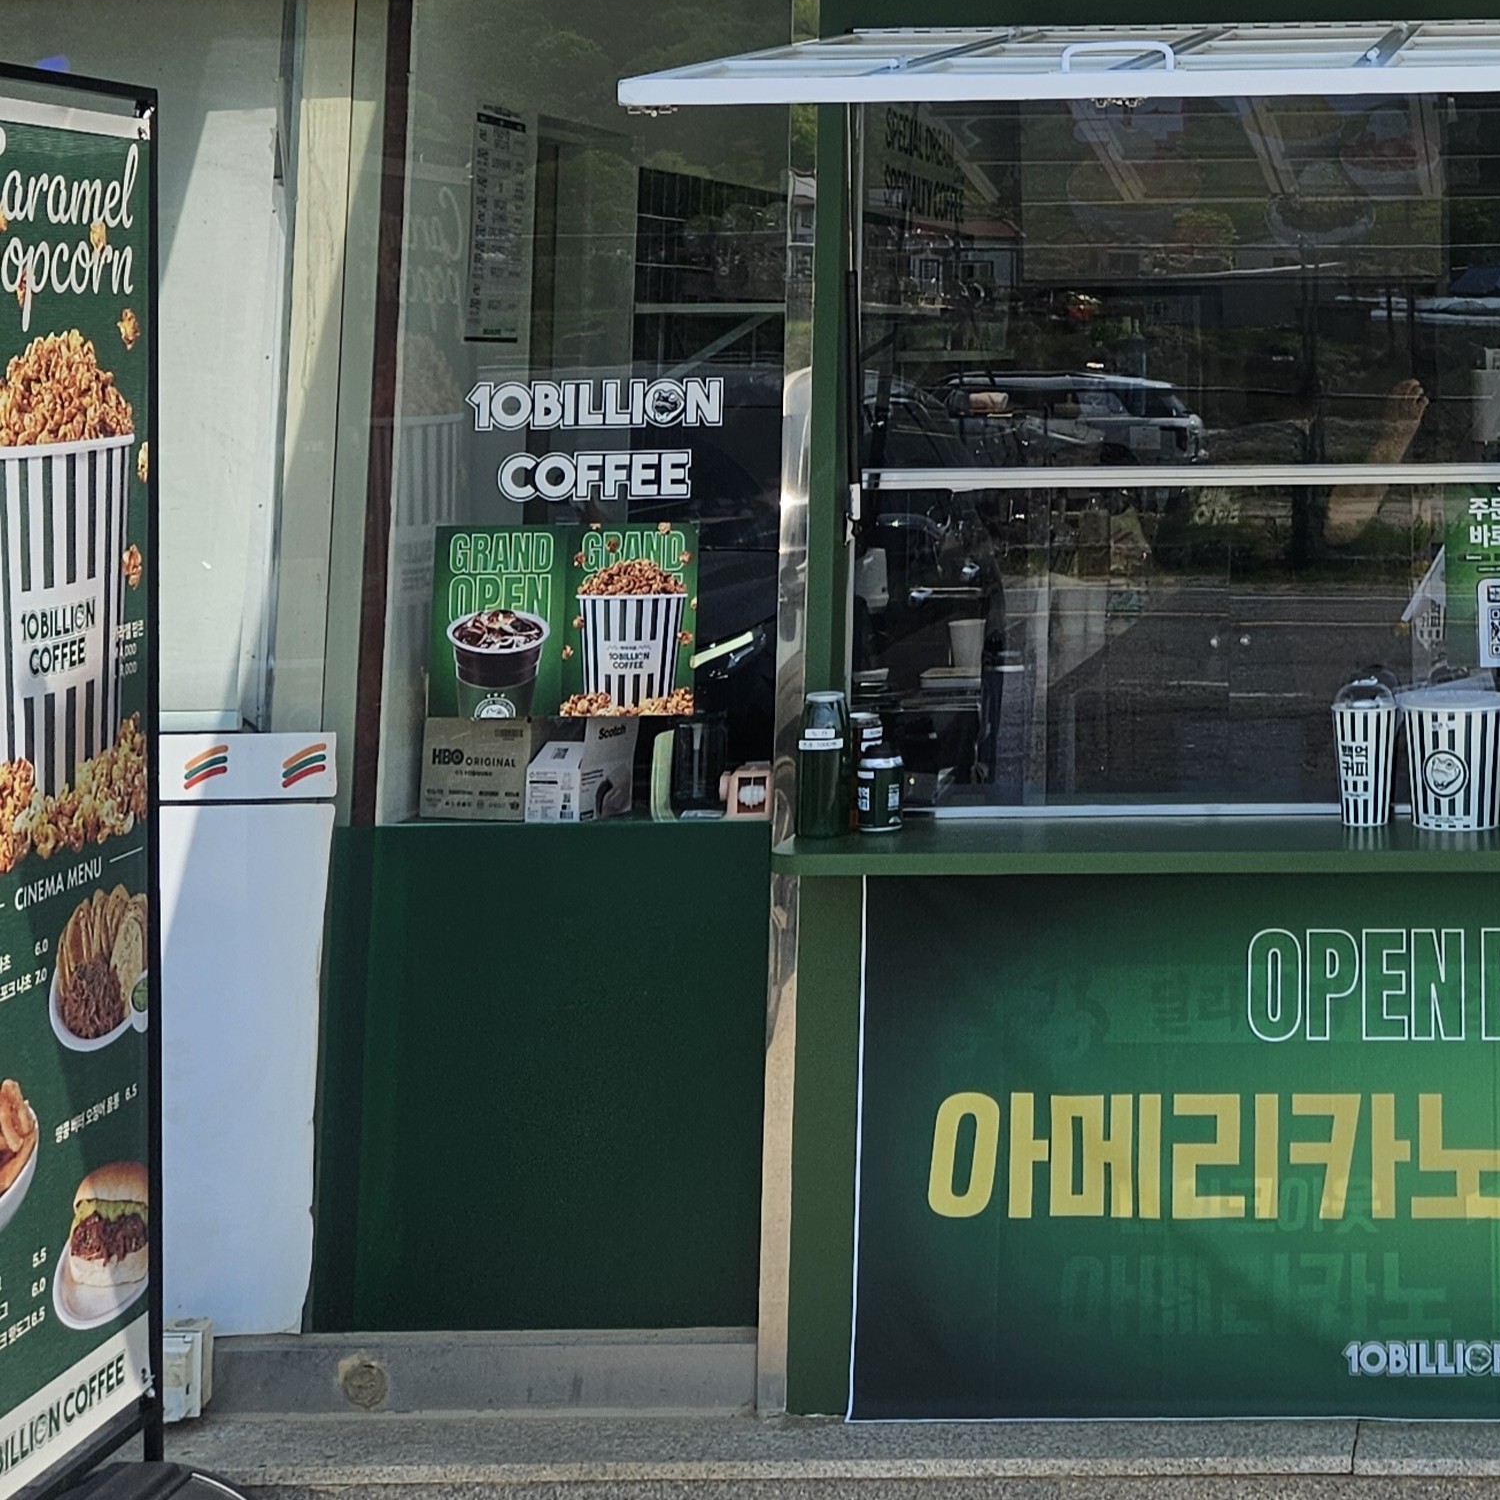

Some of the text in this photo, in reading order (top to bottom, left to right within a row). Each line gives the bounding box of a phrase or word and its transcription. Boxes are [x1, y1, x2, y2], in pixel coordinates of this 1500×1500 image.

[0, 126, 138, 229] aramel
[466, 378, 724, 431] 10BILLION
[498, 449, 691, 502] COFFEE
[450, 532, 554, 574] GRAND
[21, 598, 96, 641] 10BILLION
[448, 574, 551, 623] OPEN
[29, 634, 87, 677] COFFEE
[612, 660, 644, 670] COFFEE
[598, 723, 627, 740] Scotch
[432, 748, 516, 768] HBO ORIGINAL
[1341, 745, 1368, 761] 백억
[1342, 761, 1368, 777] 커피
[14, 855, 102, 911] CINEMA MENU
[34, 938, 48, 956] 6.0
[34, 967, 48, 986] 7.0
[1247, 928, 1466, 1042] OPEN
[32, 1247, 47, 1268] 5.5
[31, 1277, 46, 1298] 6.0
[64, 1352, 125, 1424] COFFEE
